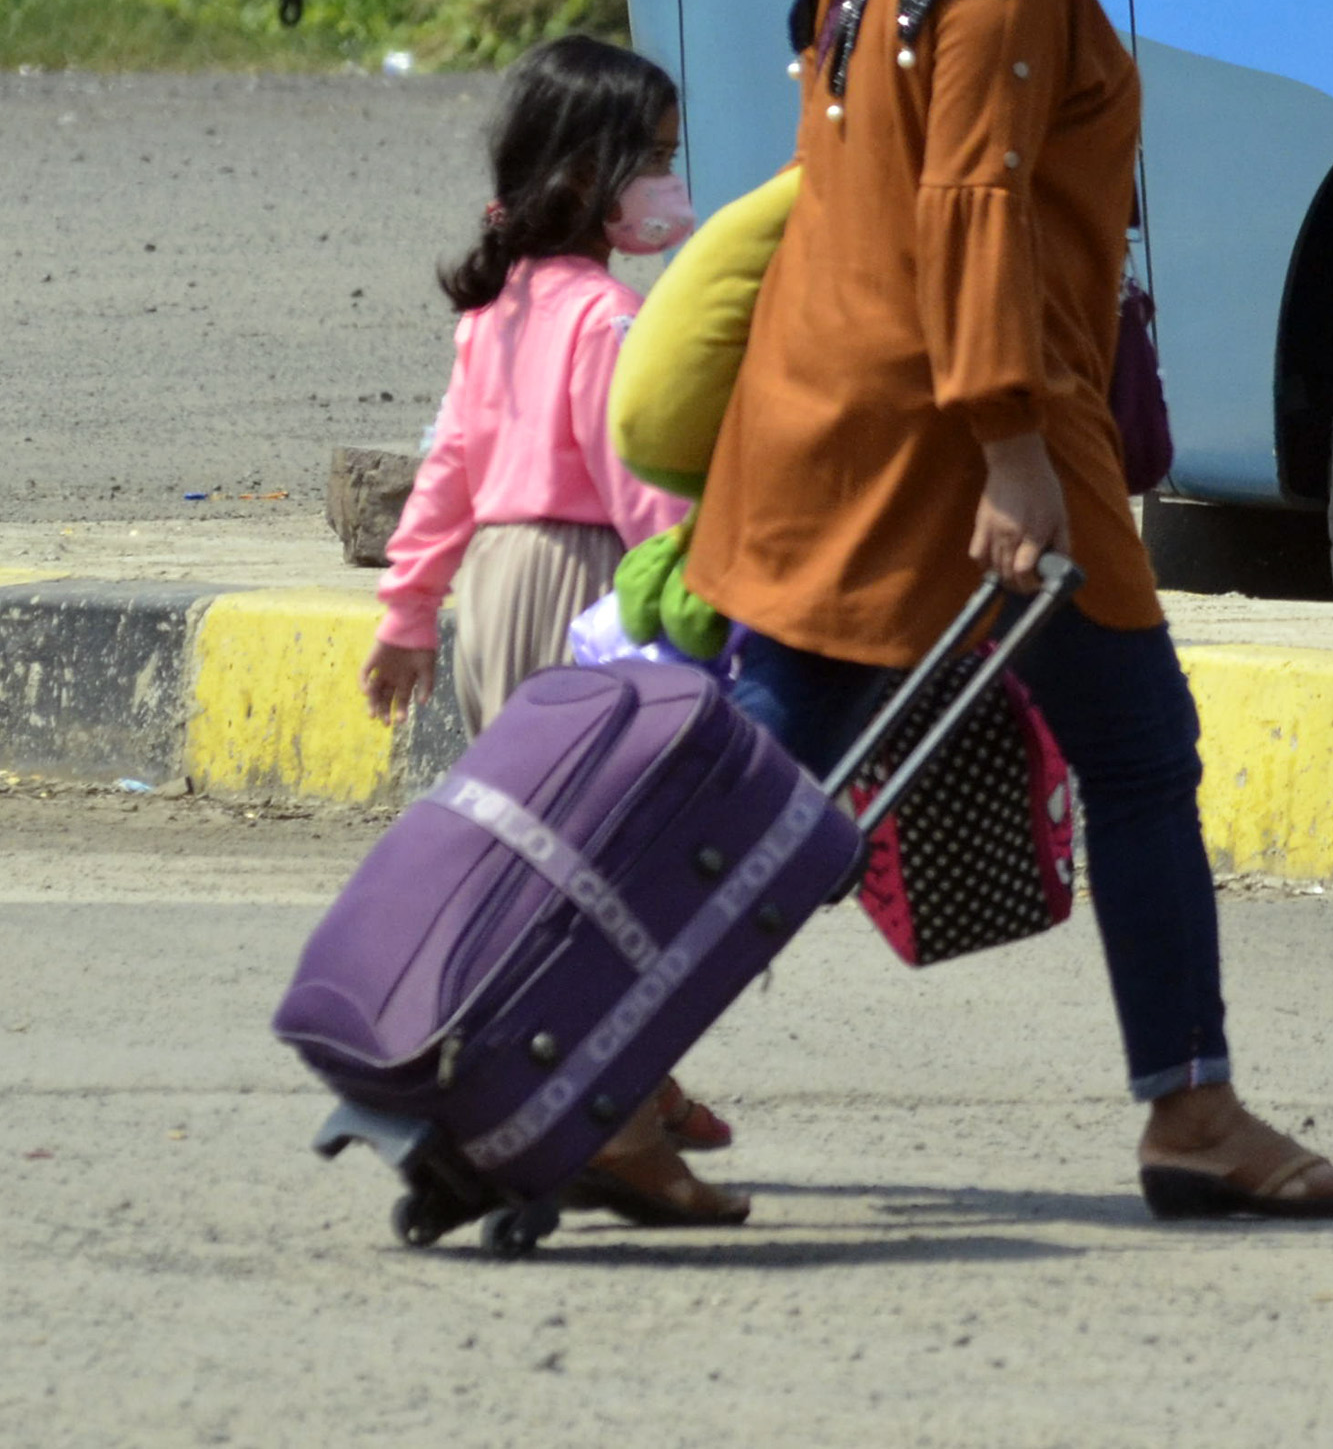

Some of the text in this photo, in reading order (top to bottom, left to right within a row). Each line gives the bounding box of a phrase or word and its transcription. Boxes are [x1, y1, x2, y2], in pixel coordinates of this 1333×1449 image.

[451, 780, 555, 863] POLO
[588, 951, 690, 1063] GOOD
[716, 802, 817, 921] POLO
